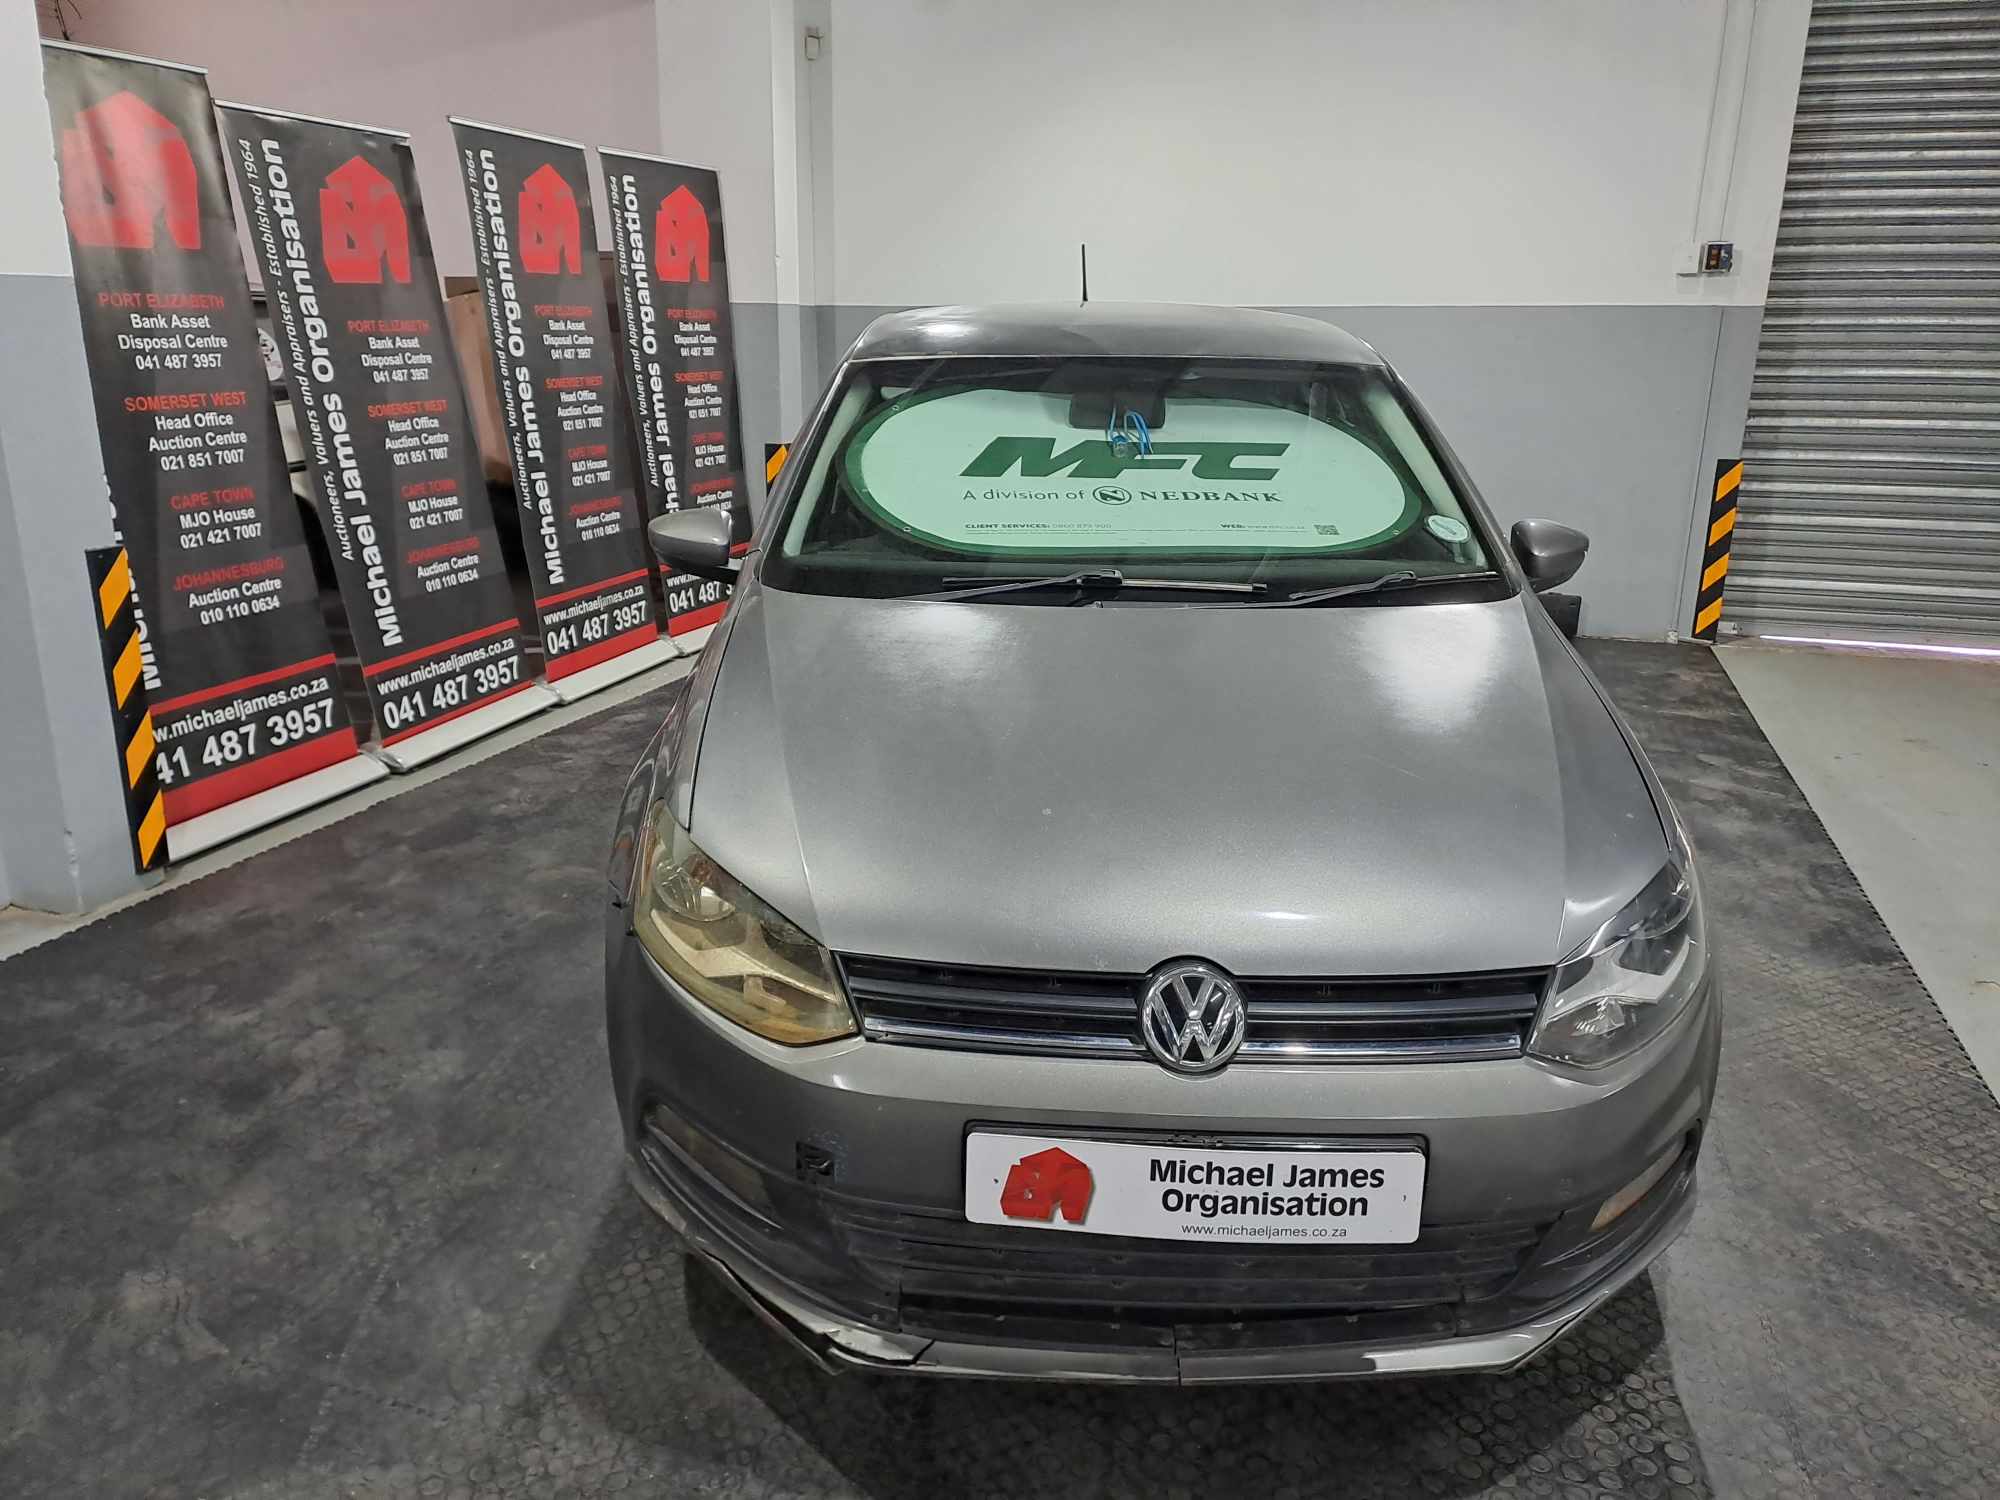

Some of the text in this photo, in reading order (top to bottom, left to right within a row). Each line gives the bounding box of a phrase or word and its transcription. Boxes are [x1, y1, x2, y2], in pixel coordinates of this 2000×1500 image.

[238, 139, 258, 180] 1964
[252, 184, 283, 276] Established
[471, 186, 490, 266] Established
[97, 293, 146, 308] PORT
[486, 277, 504, 347] Appraisers
[130, 313, 211, 330] Bank Asset
[277, 290, 306, 373] Appraisers
[118, 334, 228, 352] Disposal Centre
[368, 337, 419, 349] Bank Asset
[622, 174, 680, 513] hael James Organisation
[135, 353, 222, 370] 041 487 3957
[361, 352, 432, 367] Disposal Centre
[480, 149, 564, 585] Michael James Organisation
[496, 350, 509, 377] and
[124, 391, 247, 412] SOMERSET WEST
[261, 139, 403, 647] Michael James Organisation
[299, 376, 314, 406] and
[503, 380, 518, 427] Valuers
[155, 412, 233, 431] Head Office
[388, 417, 439, 432] Head Office
[149, 431, 247, 452] Auction Centre
[306, 410, 329, 465] Valuers
[385, 432, 449, 450] Auction Centre
[160, 449, 245, 471] 021 851 7007
[513, 432, 533, 510] Auctioneers,
[169, 487, 255, 510] CAPE TOWN
[430, 495, 457, 508] House
[963, 490, 976, 500] A
[983, 488, 1059, 501] division
[1066, 488, 1085, 500] of
[1140, 490, 1284, 502] NEDBANK
[179, 507, 255, 529] MJO House
[323, 470, 354, 561] Auctioneers,
[180, 523, 262, 549] 021 421 7007
[417, 554, 478, 578] Auction Centre
[188, 577, 283, 608] Auction Centre
[670, 588, 695, 612] 041
[699, 581, 720, 603] 487
[200, 594, 281, 626] 010 110 0634
[547, 600, 647, 655] 041 487 3957
[377, 637, 514, 695] www.michaeljames.co.za
[383, 656, 519, 729] 041 487 3957
[154, 677, 329, 743] w.michaeljames.co.za
[156, 699, 334, 784] 41 487 3957
[1149, 1158, 1385, 1189] Michael James
[1161, 1188, 1368, 1218] Organisation
[1181, 1223, 1347, 1239] www.michaeljames.co.za
